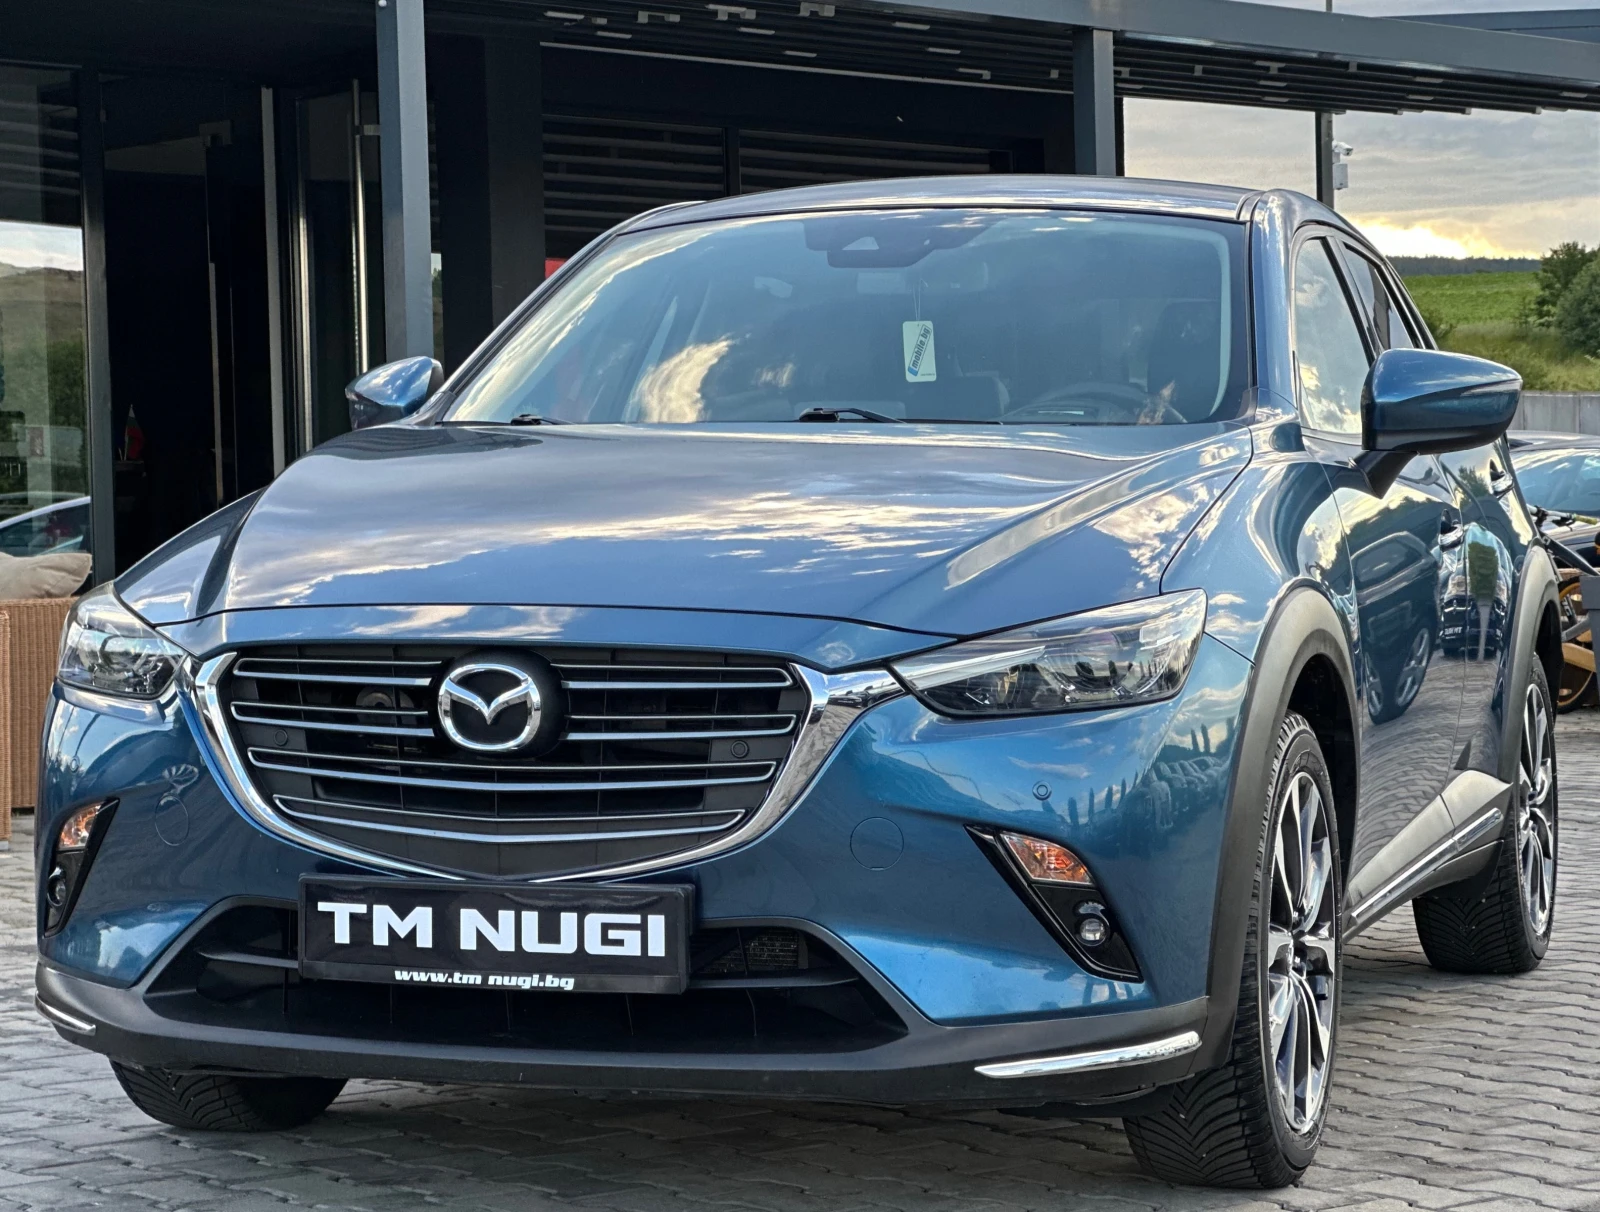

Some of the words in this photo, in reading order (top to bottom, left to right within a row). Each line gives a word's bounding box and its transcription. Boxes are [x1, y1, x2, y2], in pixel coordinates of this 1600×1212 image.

[911, 326, 931, 370] mobile.bg
[317, 901, 433, 949] TM
[459, 908, 666, 957] NUGI
[394, 970, 482, 985] www.tm
[487, 974, 575, 991] nugi.bg
